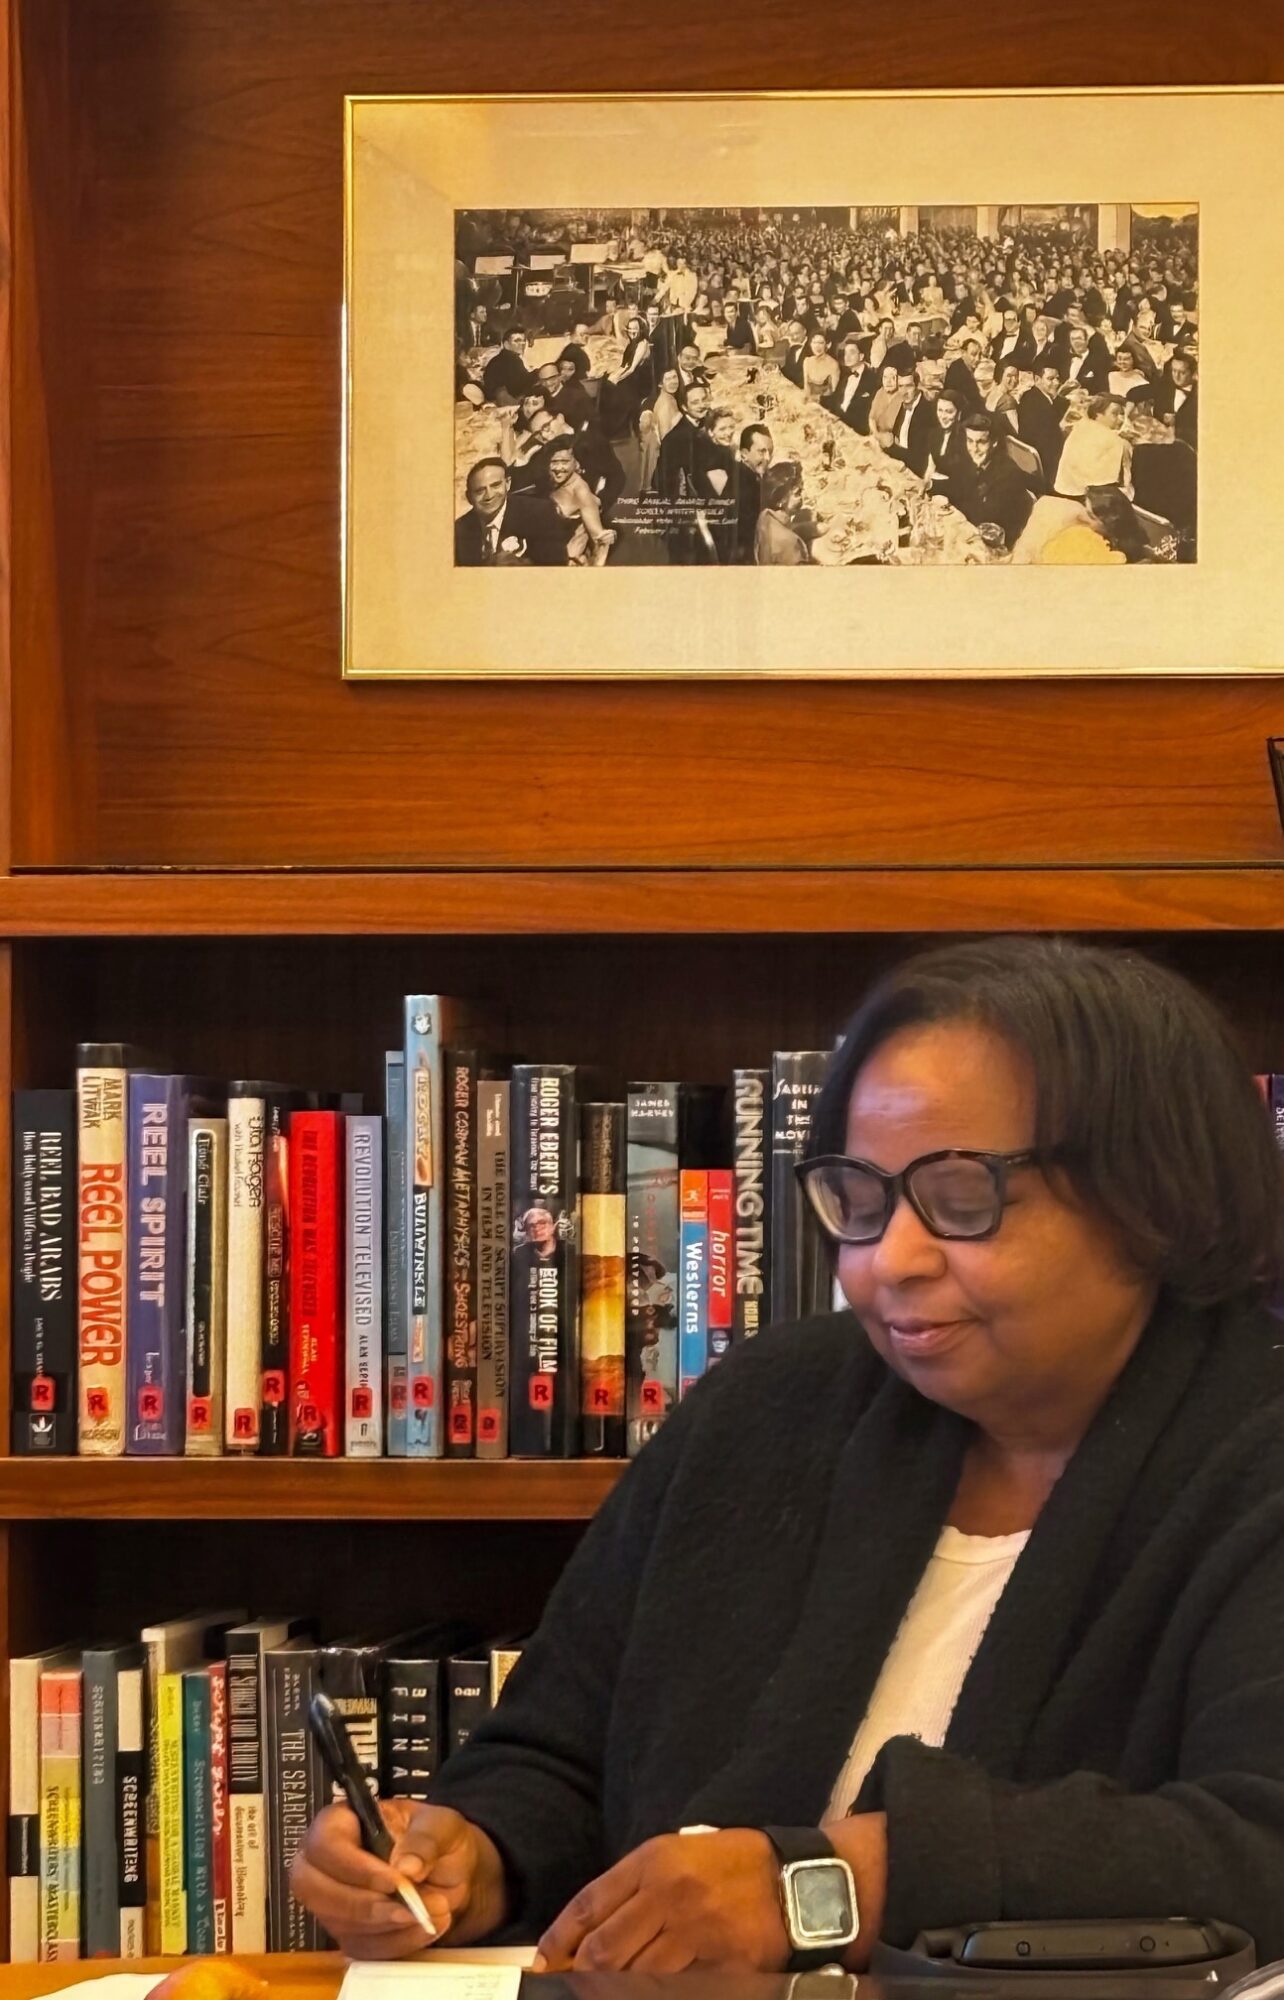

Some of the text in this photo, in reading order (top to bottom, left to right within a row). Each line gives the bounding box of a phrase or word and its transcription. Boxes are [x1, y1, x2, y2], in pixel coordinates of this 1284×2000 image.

[82, 1076, 102, 1129] LITWAK
[103, 1077, 122, 1121] MARK
[456, 1067, 469, 1108] ROGER
[791, 1099, 808, 1110] IN
[456, 1111, 469, 1166] CORMAN
[539, 1077, 560, 1194] ROGER EBERT'S
[140, 1103, 168, 1308] REEL SPIRIT
[245, 1152, 263, 1208] Hagen
[735, 1078, 764, 1294] RUNNING TIME
[40, 1131, 62, 1302] REEL BAD ARABS
[355, 1134, 372, 1326] REVOLUTION TELEVISED
[452, 1167, 471, 1267] METAPHYSICS
[80, 1162, 123, 1368] REEL POWER
[413, 1192, 427, 1308] BULLWINKLE
[481, 1187, 492, 1361] IN FILM AND TELEVISION
[494, 1151, 506, 1398] THE ROLE OF SCRIPT SUPERVISION
[711, 1229, 731, 1298] horror
[686, 1242, 704, 1335] Westerns
[359, 1334, 369, 1358] ALAN
[454, 1282, 471, 1368] SHOESTRING
[538, 1267, 558, 1372] BOOK OF FILM
[36, 1384, 50, 1402] R
[90, 1394, 106, 1412] R
[143, 1395, 159, 1414] R
[264, 1376, 281, 1394] R
[356, 1394, 369, 1411] R
[414, 1382, 429, 1400] R
[534, 1384, 549, 1402] R
[594, 1388, 609, 1406] R
[643, 1388, 658, 1405] R
[193, 1406, 208, 1423] R
[237, 1414, 251, 1432] R
[303, 1404, 318, 1421] R
[230, 1653, 259, 1782] THE SEARCH FOR REALITY
[281, 1728, 306, 1762] THE
[123, 1775, 138, 1883] SCREENWRITING
